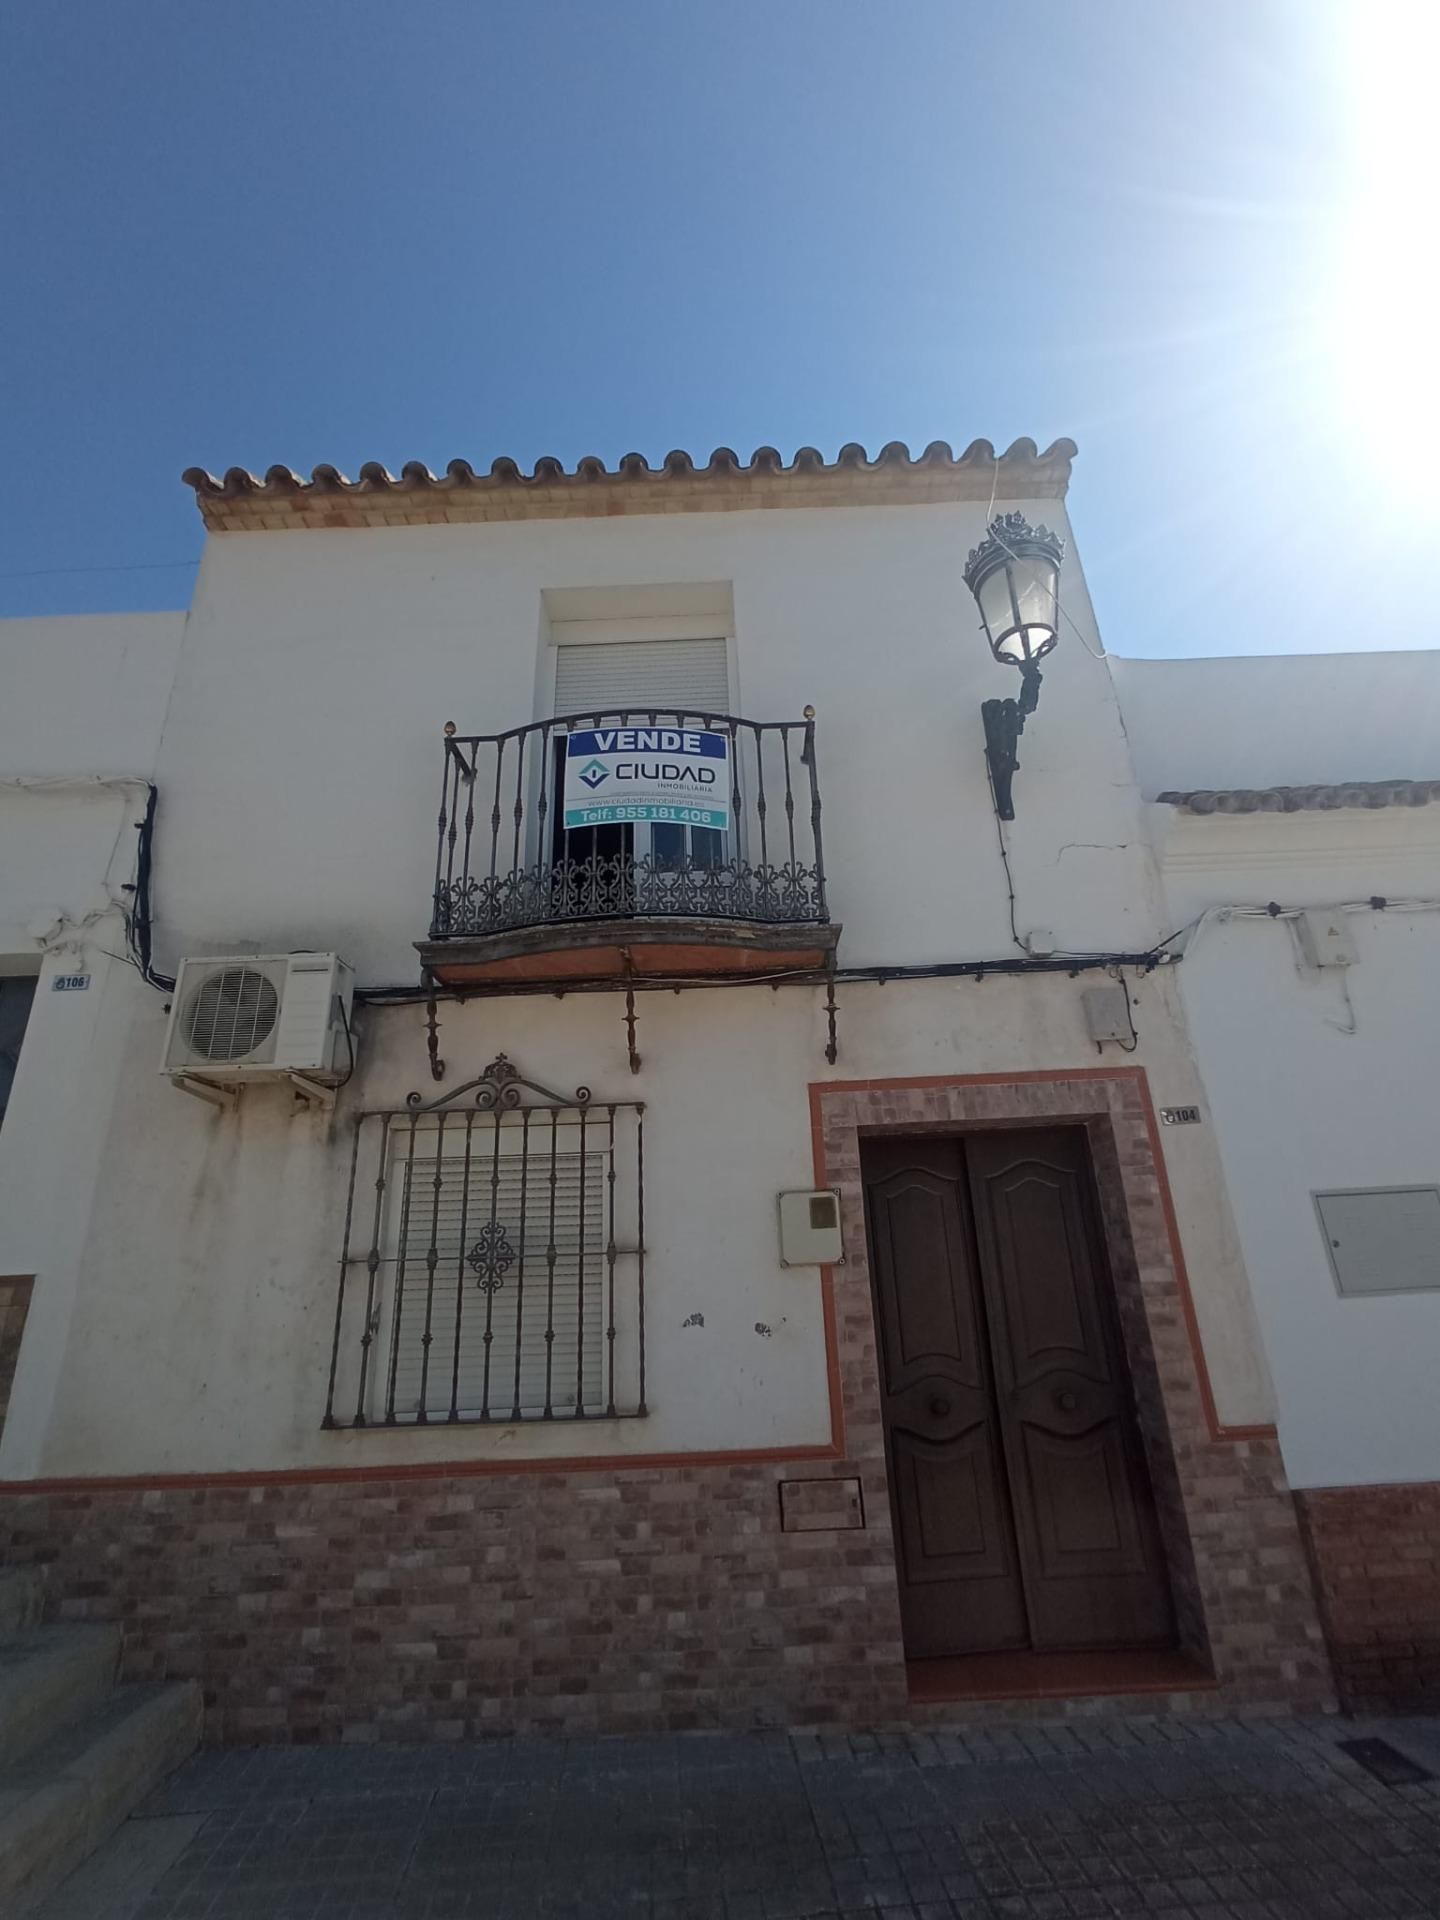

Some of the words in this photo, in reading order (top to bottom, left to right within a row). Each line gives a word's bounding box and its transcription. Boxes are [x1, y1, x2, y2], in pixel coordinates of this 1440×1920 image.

[595, 731, 702, 753] VENDE
[615, 763, 716, 784] CIUDAD
[657, 783, 713, 793] INMOBILIARIA
[581, 808, 612, 822] Telf:
[616, 807, 648, 819] 955
[651, 807, 677, 819] 181
[680, 809, 712, 824] 406
[1175, 1109, 1196, 1121] 104
